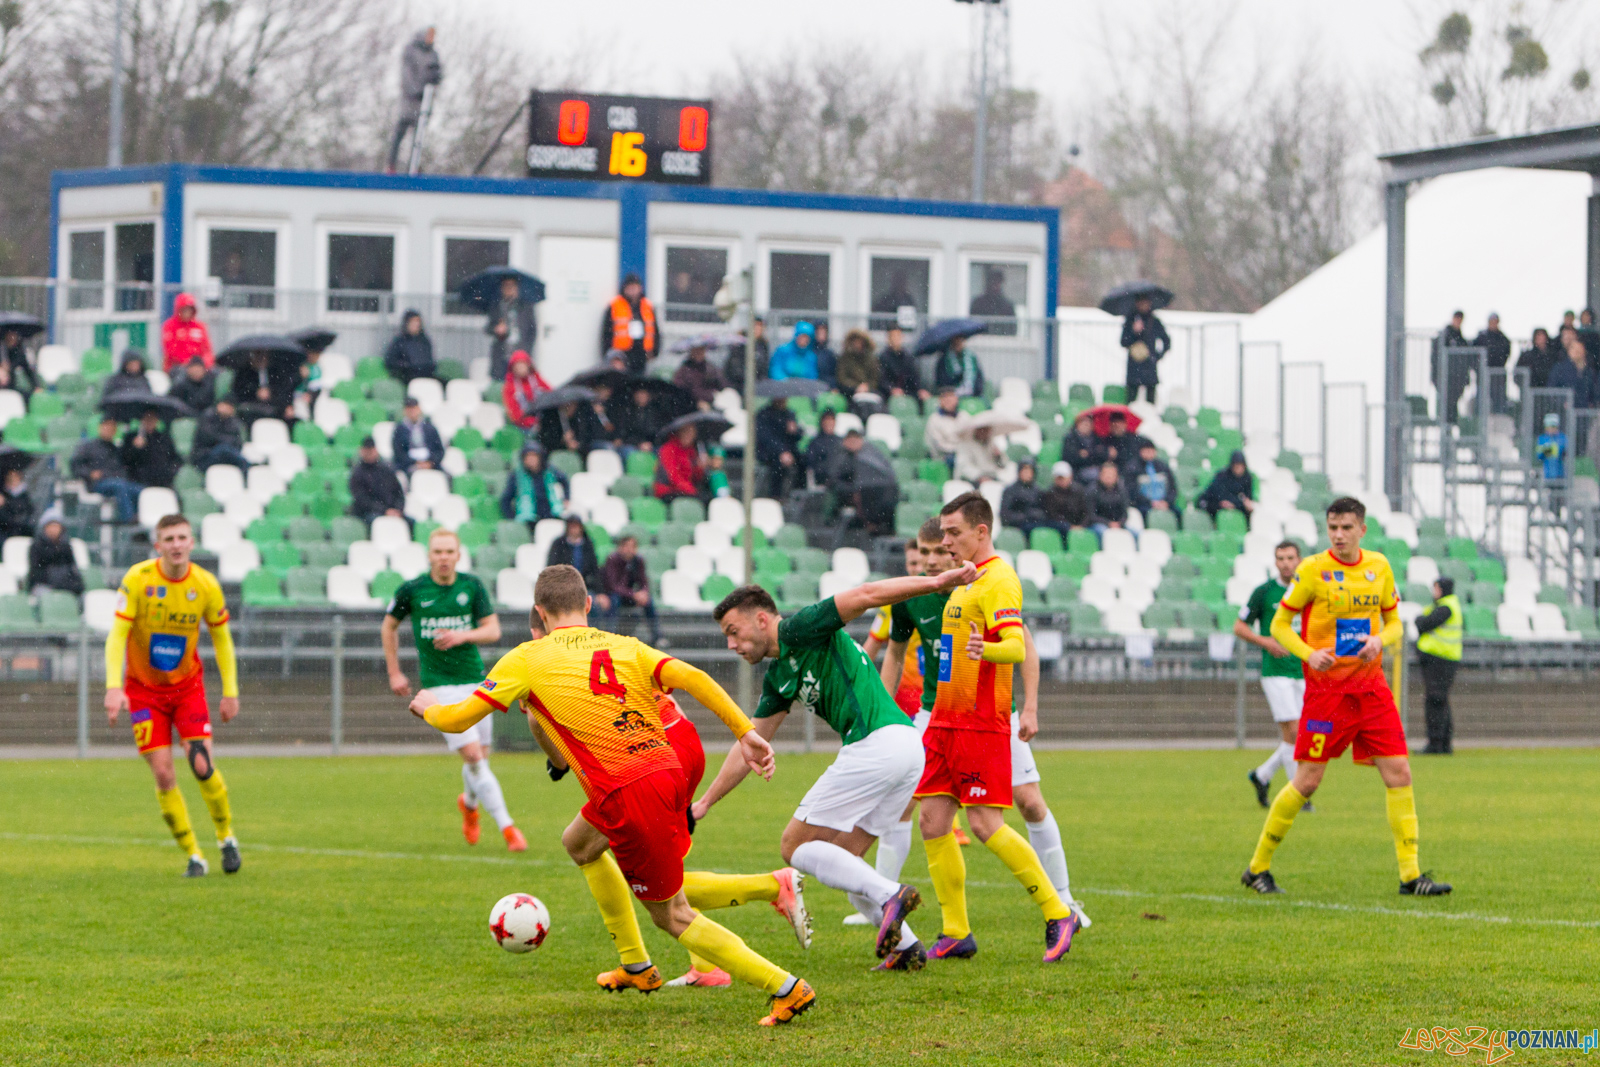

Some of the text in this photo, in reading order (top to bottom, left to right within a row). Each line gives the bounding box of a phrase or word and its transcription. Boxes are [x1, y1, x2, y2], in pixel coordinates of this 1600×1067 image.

[558, 100, 590, 146] 0
[678, 106, 709, 152] 0
[608, 131, 648, 177] 16
[420, 613, 473, 628] FAMILY
[554, 632, 588, 650] vippi
[589, 649, 628, 704] 4
[132, 719, 153, 747] 27
[1308, 732, 1327, 758] 3
